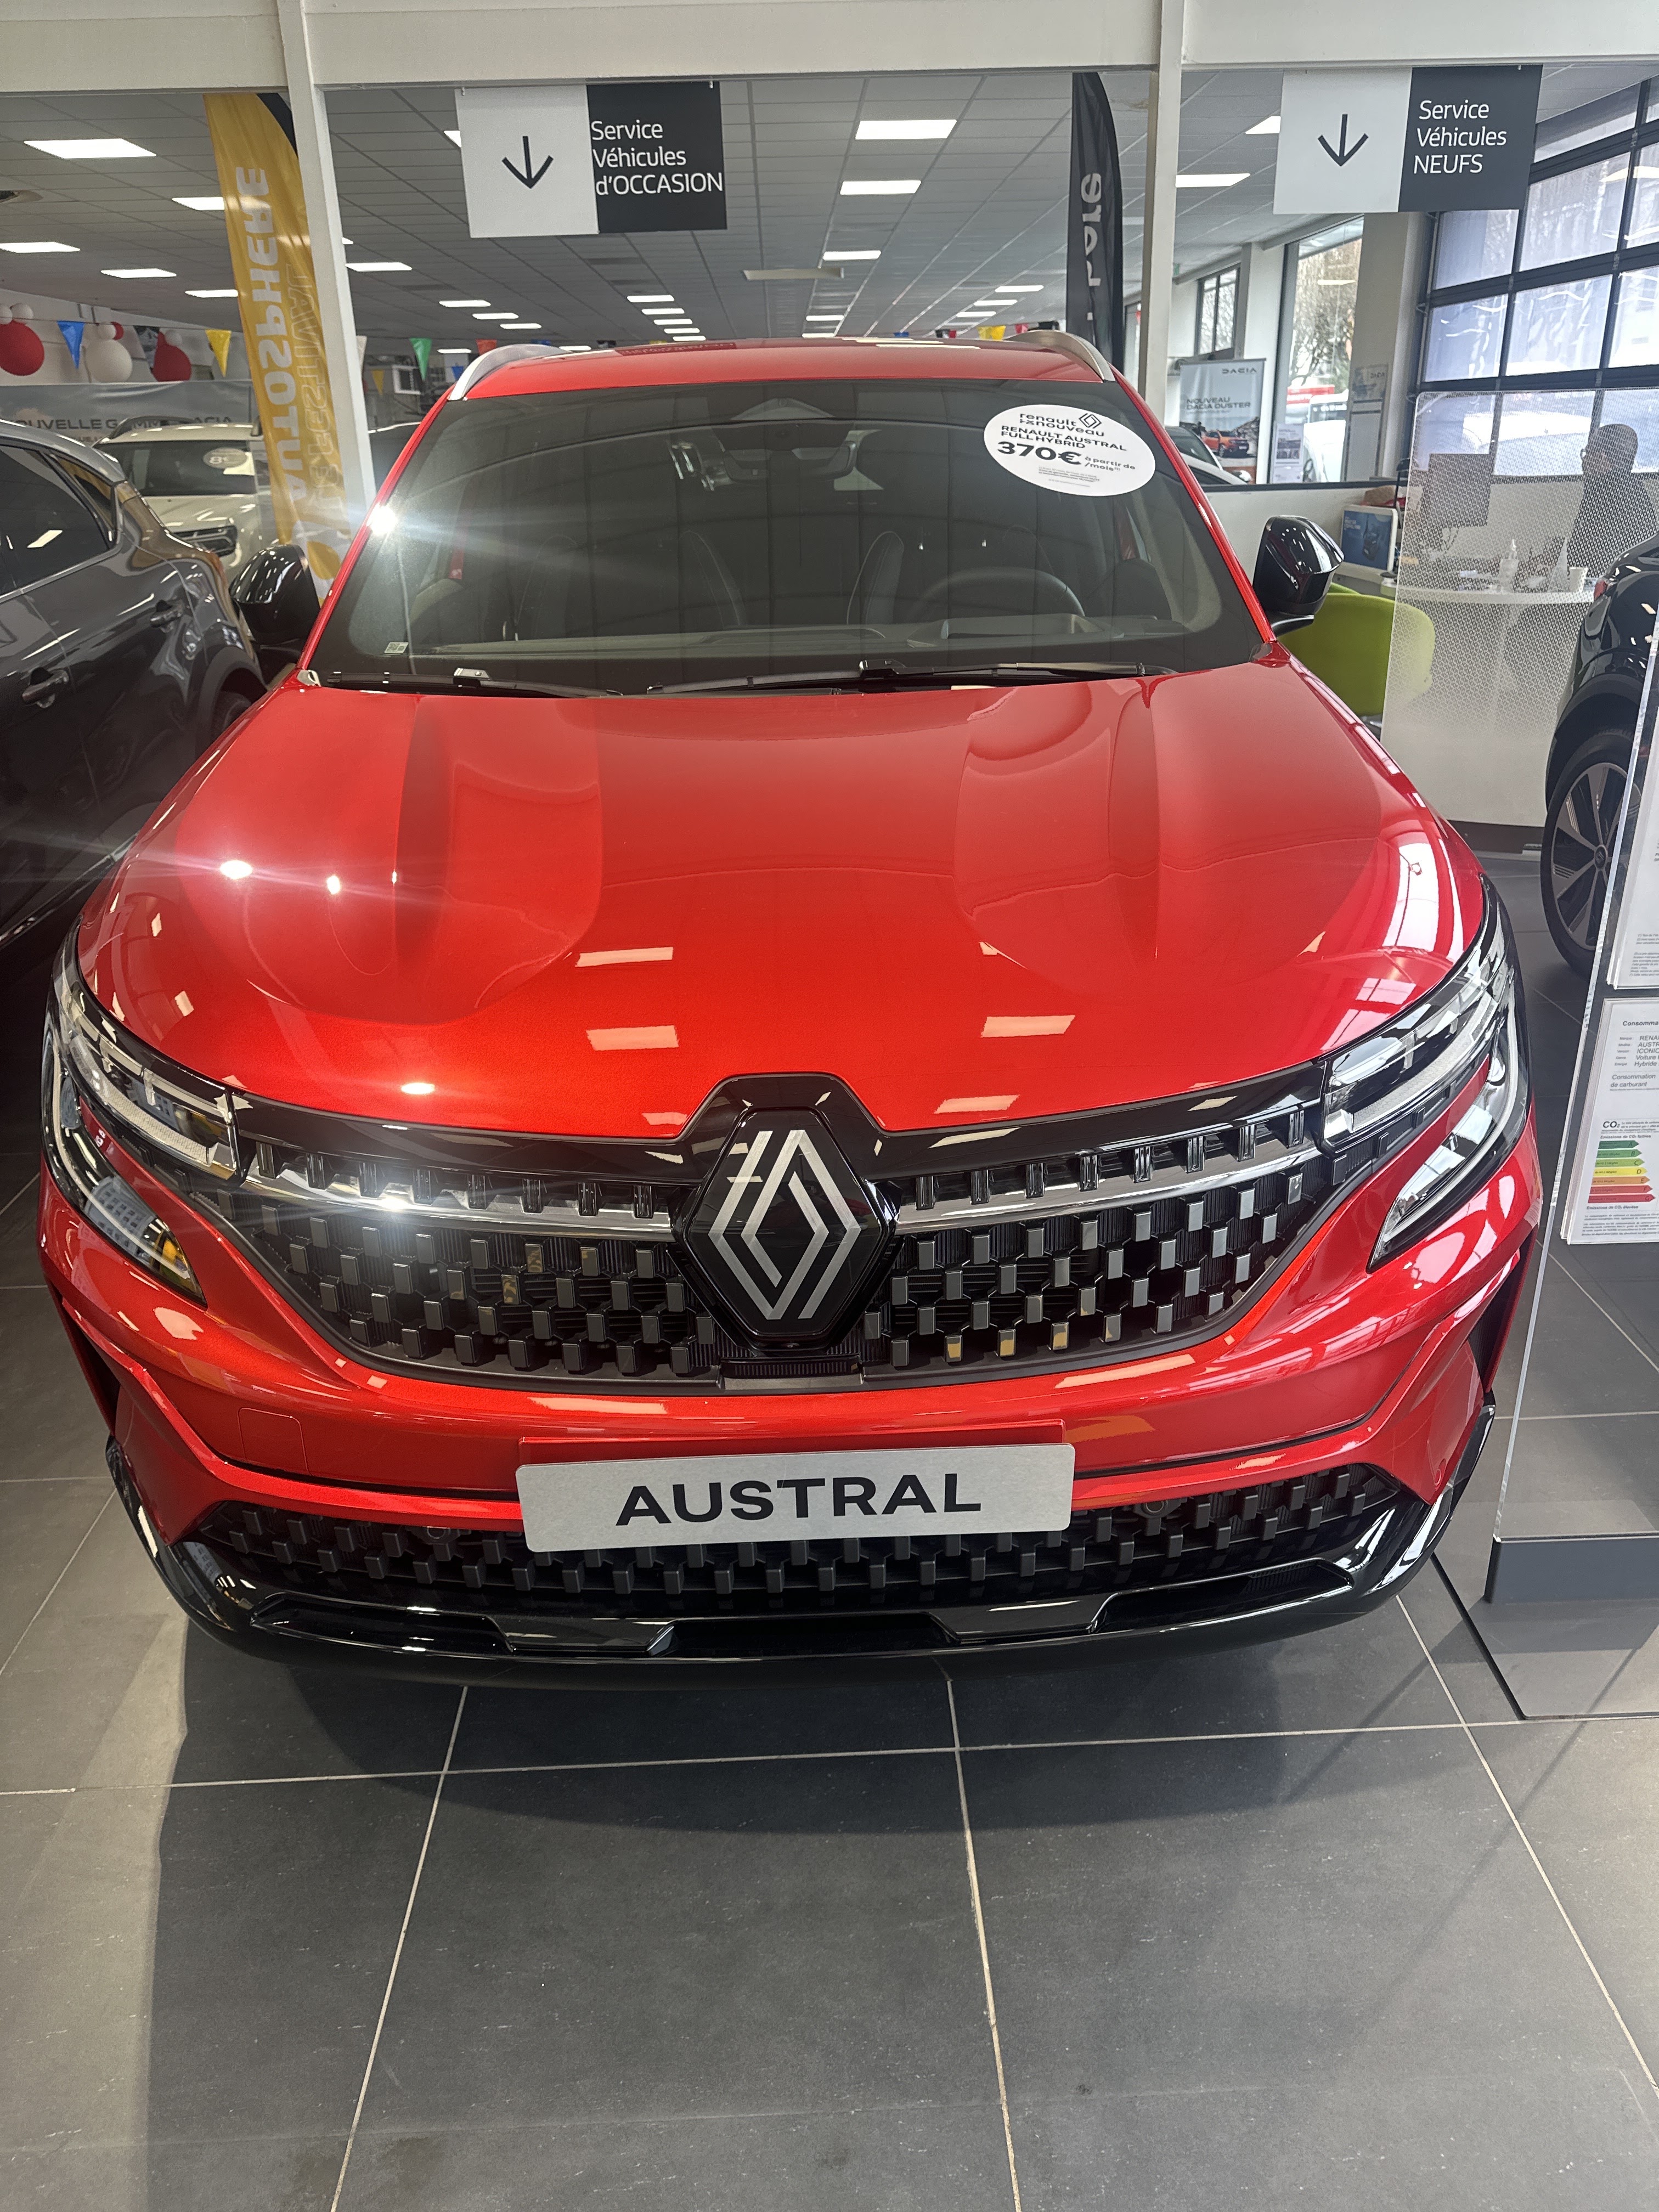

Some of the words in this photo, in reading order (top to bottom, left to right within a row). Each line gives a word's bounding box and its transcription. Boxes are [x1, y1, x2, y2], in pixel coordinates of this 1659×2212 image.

[1419, 99, 1489, 120] Service
[590, 119, 663, 140] Service
[1417, 126, 1507, 147] Véhicules
[592, 146, 686, 167] Véhicules
[1414, 154, 1483, 174] NEUFS
[596, 172, 723, 196] d'OCCASION
[1020, 413, 1077, 427] renault
[1001, 425, 1063, 438] RENAULT
[1065, 435, 1127, 452] AUSTRAL
[1001, 431, 1033, 441] FULL
[1036, 436, 1086, 449] HYBRID
[997, 441, 1082, 465] 370€
[1093, 458, 1122, 467] partir
